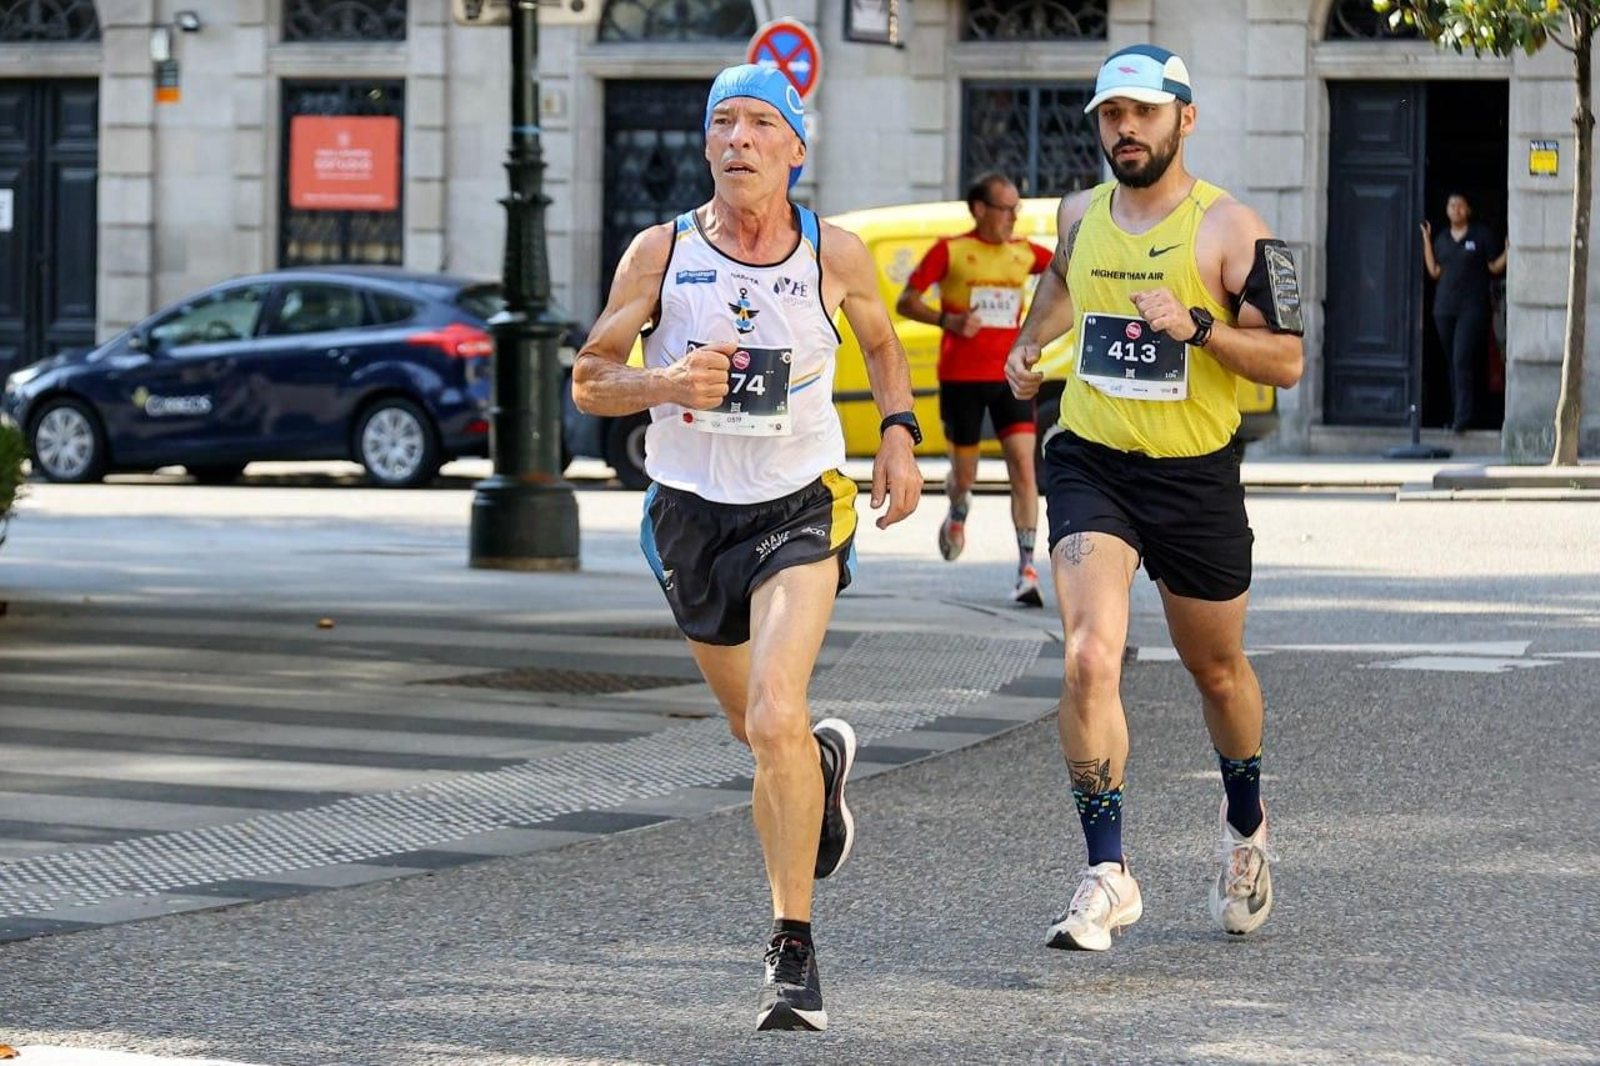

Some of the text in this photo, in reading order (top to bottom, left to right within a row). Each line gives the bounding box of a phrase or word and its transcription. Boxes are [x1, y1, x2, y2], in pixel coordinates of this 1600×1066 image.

[1090, 268, 1164, 281] HIGHER THAN AIR
[1107, 340, 1157, 364] 413
[730, 372, 766, 396] 74
